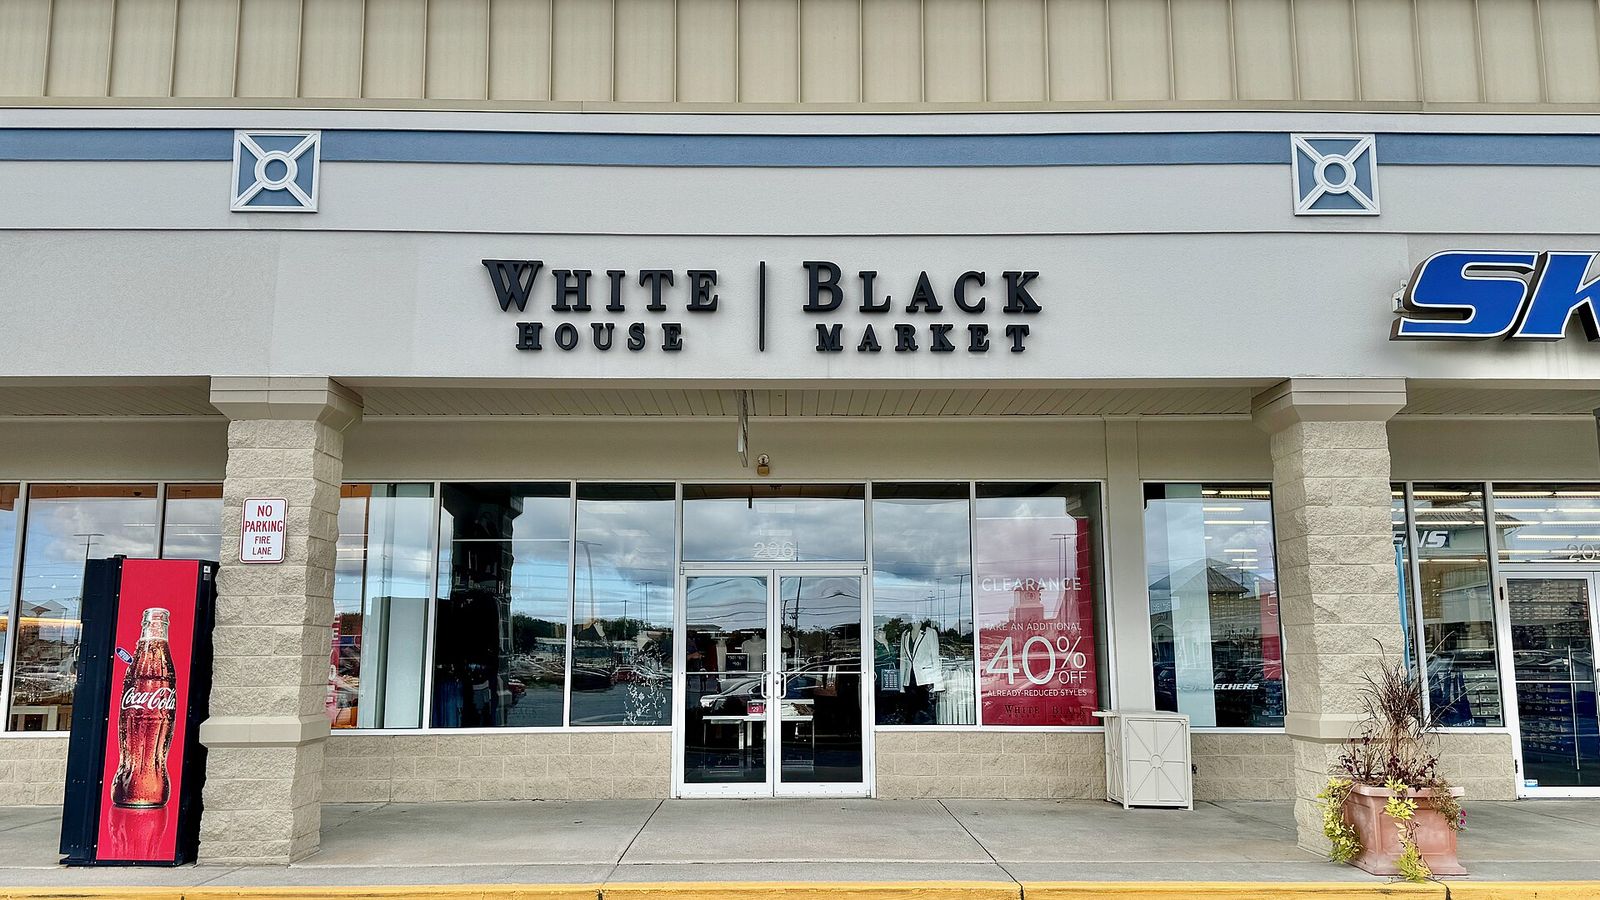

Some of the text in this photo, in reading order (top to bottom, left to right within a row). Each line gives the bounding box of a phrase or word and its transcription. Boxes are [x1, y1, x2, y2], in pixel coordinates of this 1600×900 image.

[481, 259, 1042, 313] WHITE BLACK
[516, 322, 1030, 353] HOUSE MARKET
[257, 505, 273, 517] NO
[245, 520, 283, 533] PARKING
[254, 535, 272, 545] FIRE
[252, 546, 272, 556] LANE
[1568, 543, 1600, 560] 20
[981, 577, 1082, 591] CLEARANCE
[984, 622, 1083, 631] TAKE AN ADDITIONAL
[985, 635, 1087, 685] 40%
[1058, 670, 1088, 684] OFF
[987, 689, 1088, 697] ALREADY-REDUCED STYLES
